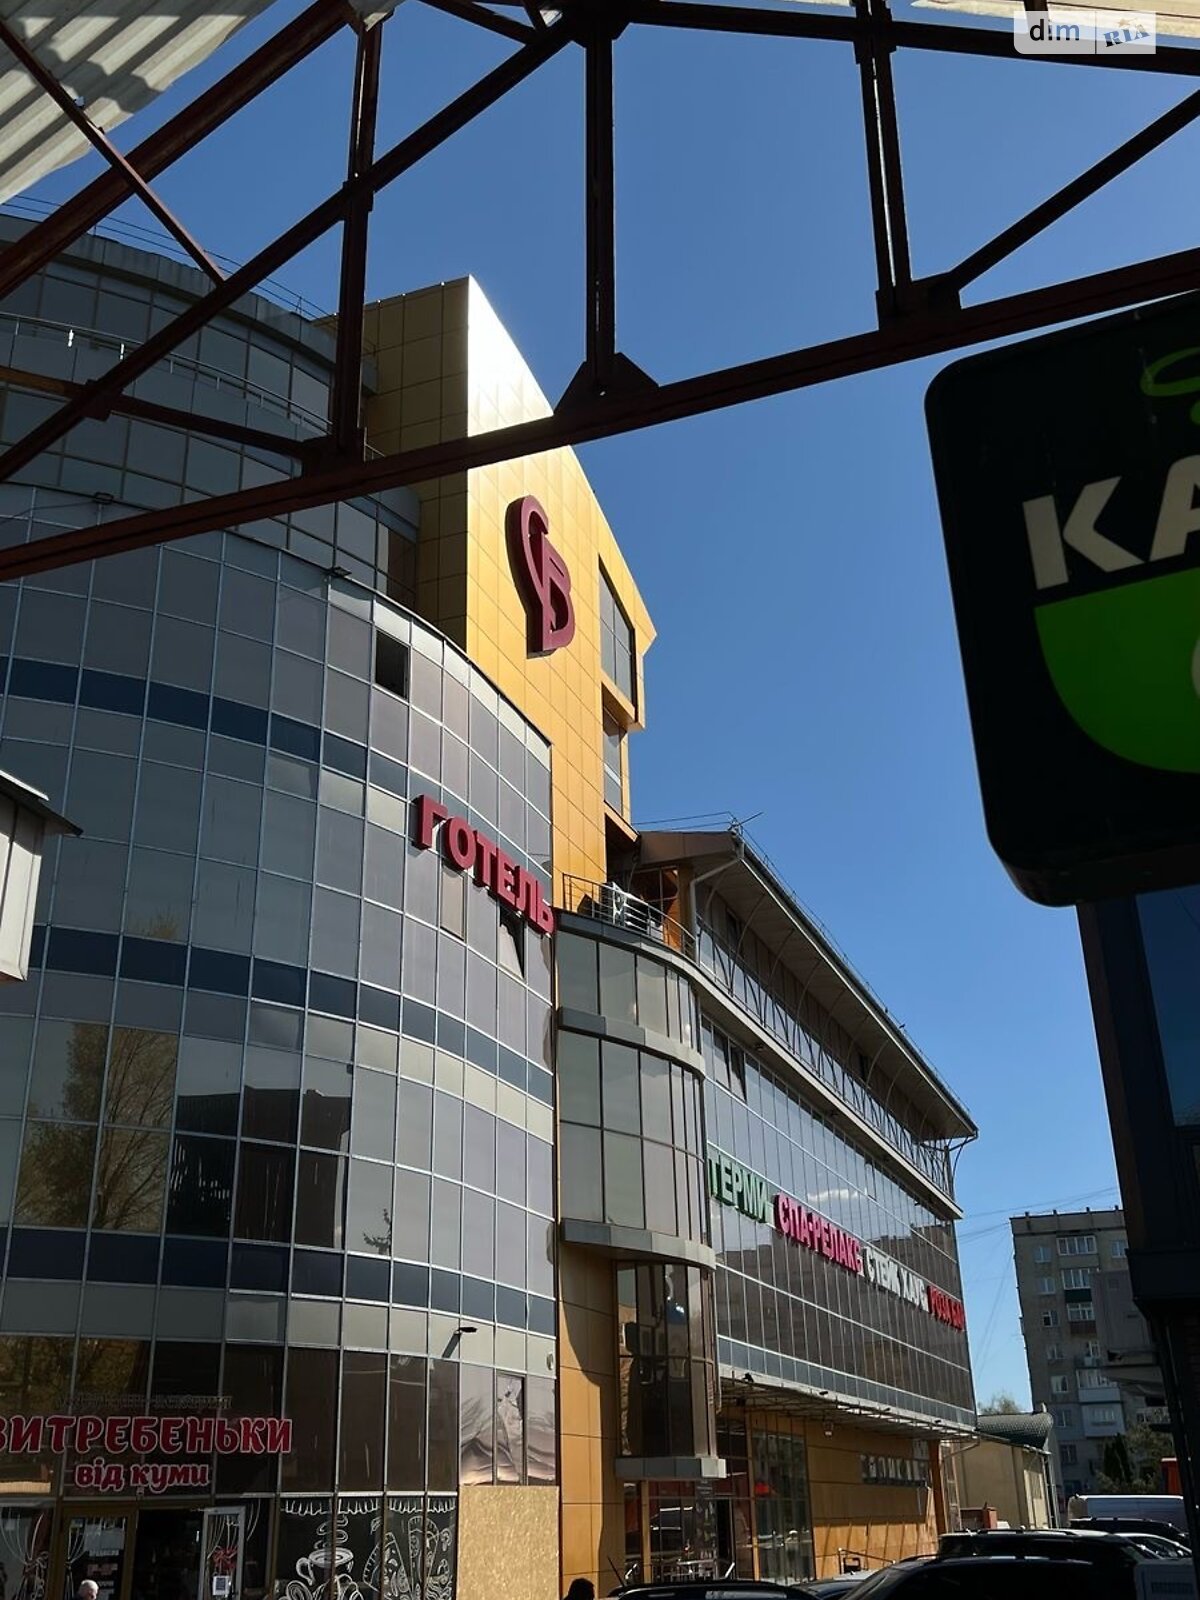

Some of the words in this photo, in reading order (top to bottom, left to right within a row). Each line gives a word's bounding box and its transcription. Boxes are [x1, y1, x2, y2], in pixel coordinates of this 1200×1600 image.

[415, 794, 556, 936] ГОТЕЛЬ
[75, 1456, 125, 1491] від
[130, 1463, 210, 1494] куми
